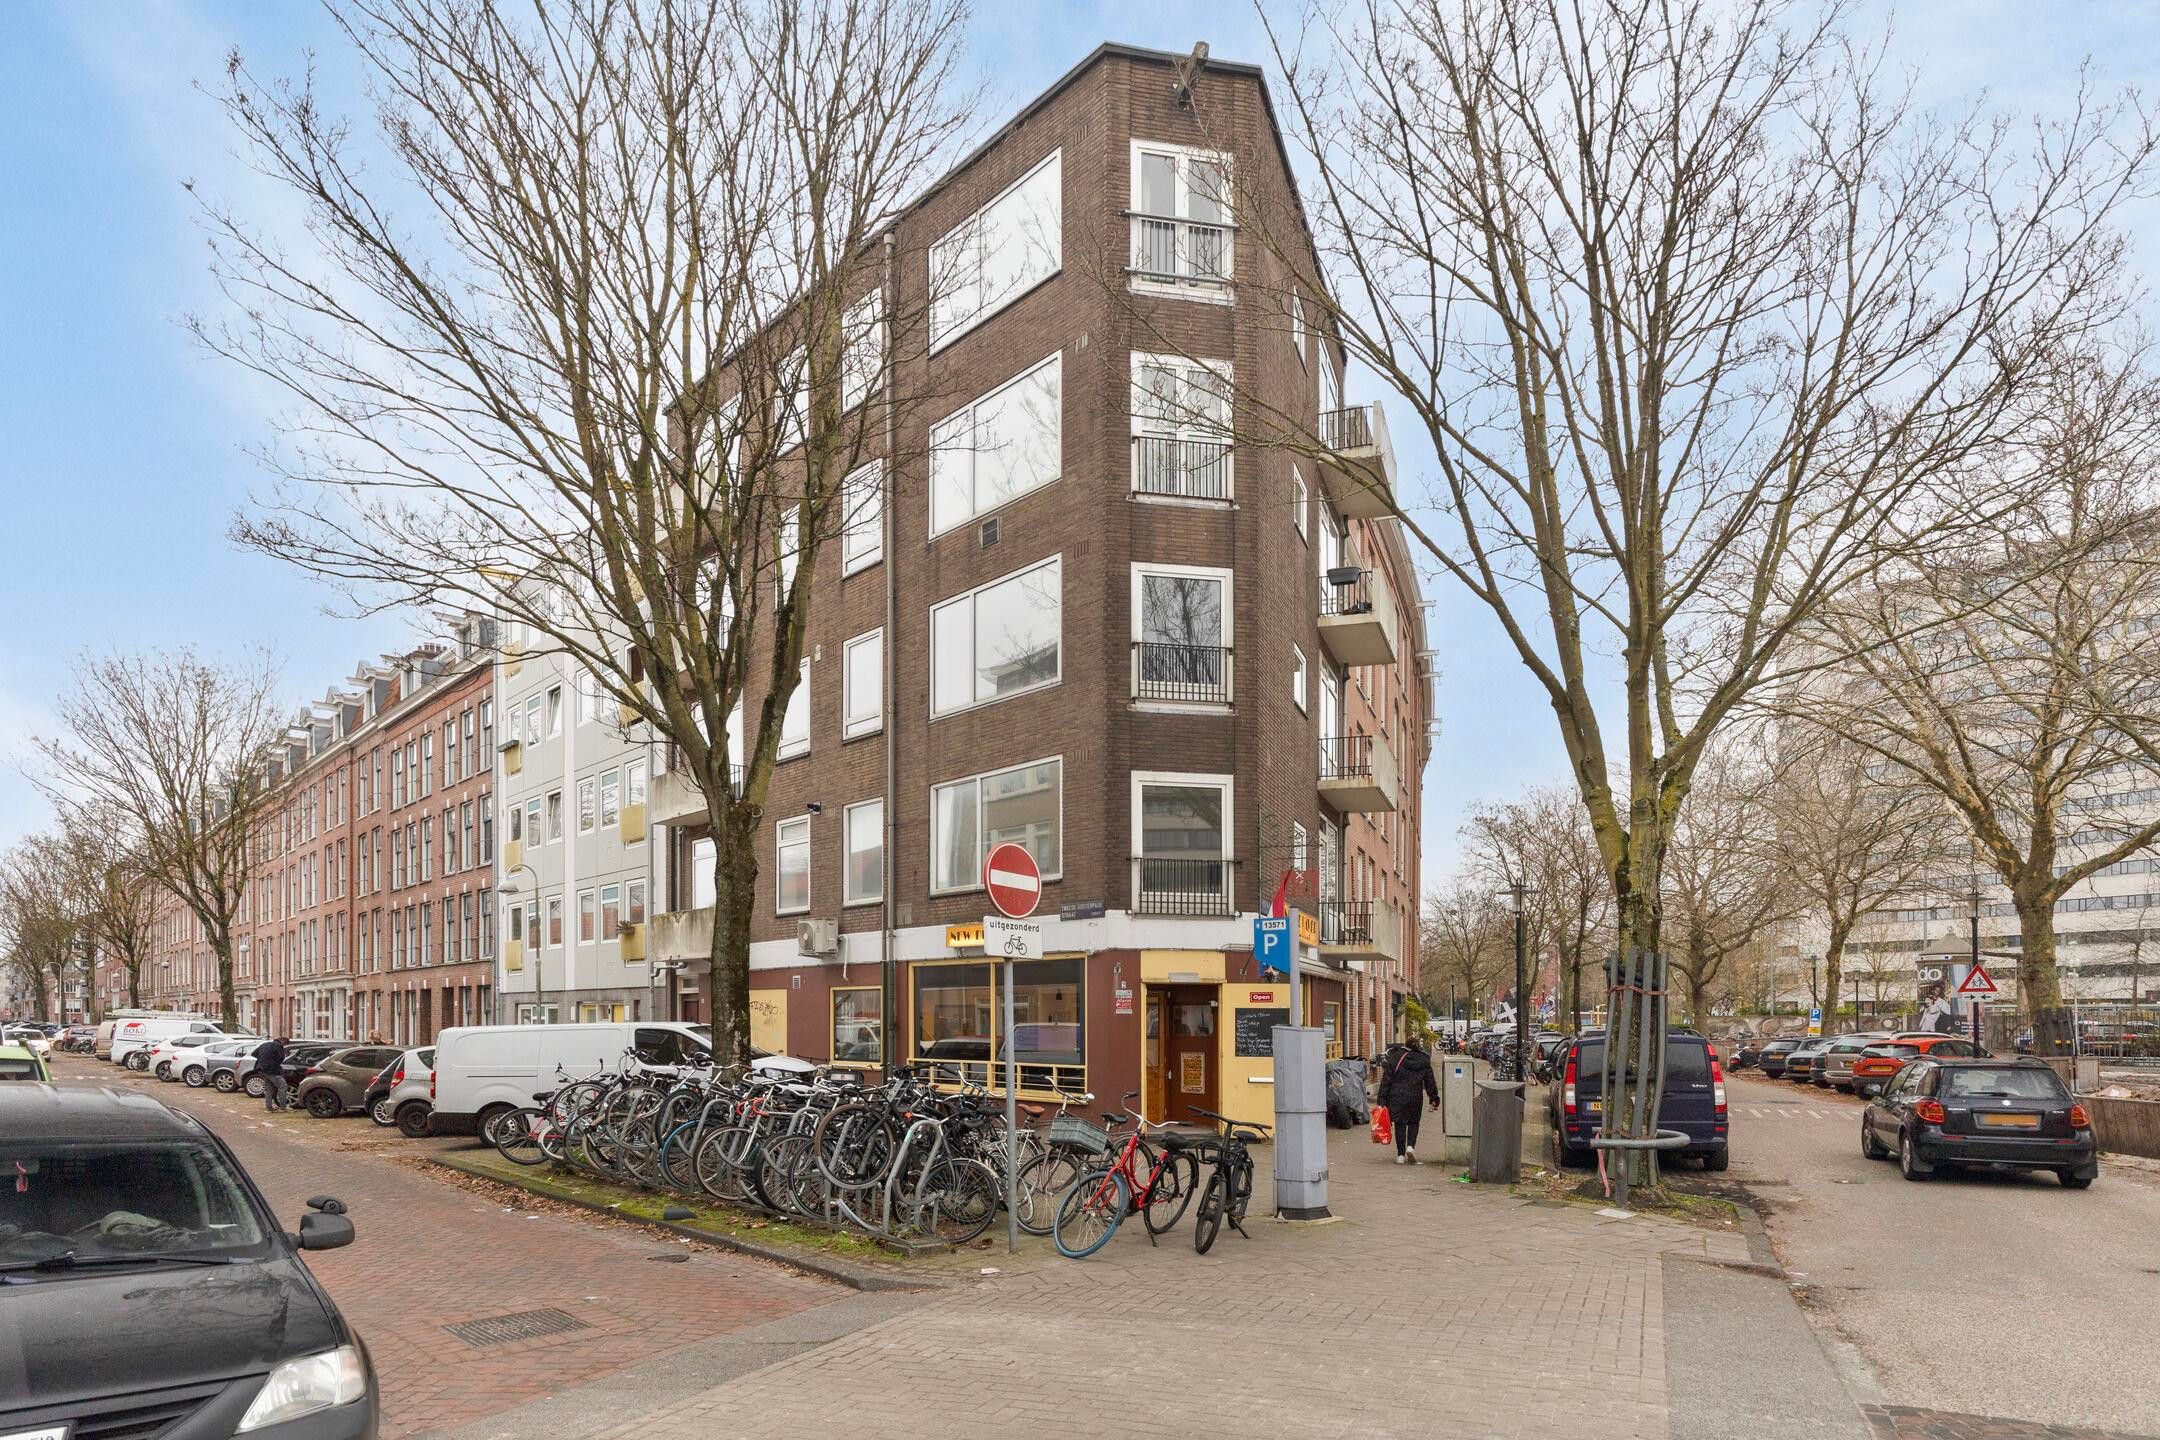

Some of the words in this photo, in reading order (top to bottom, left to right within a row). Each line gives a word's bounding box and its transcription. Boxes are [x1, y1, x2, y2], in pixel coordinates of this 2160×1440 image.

[989, 920, 1040, 933] uitgezonderd
[950, 930, 971, 941] NEW
[1264, 933, 1278, 955] P
